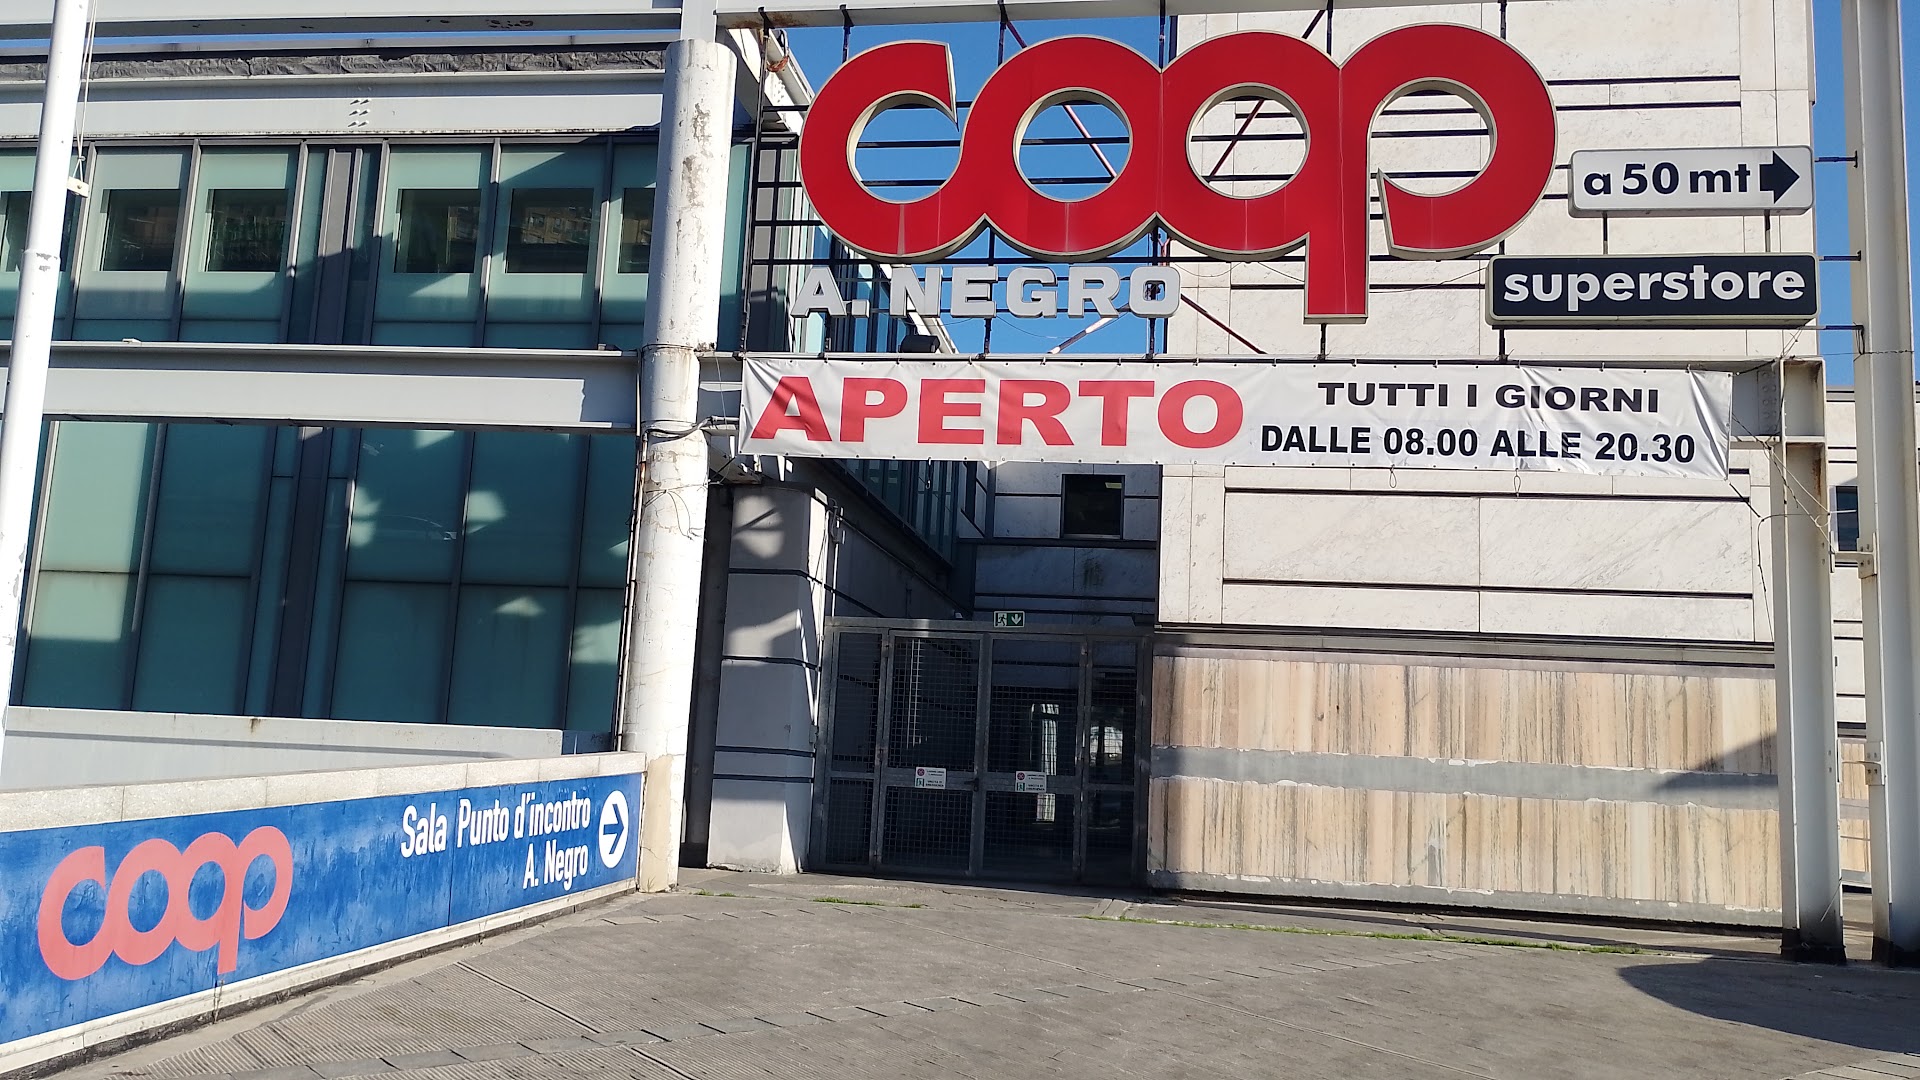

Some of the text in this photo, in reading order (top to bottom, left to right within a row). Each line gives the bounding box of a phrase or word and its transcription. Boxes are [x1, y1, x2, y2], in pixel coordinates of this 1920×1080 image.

[800, 21, 1557, 322] coop
[1584, 162, 1751, 195] a 50 mt
[790, 265, 1181, 318] A. NEGRO
[1503, 264, 1806, 312] superstore
[750, 376, 1244, 449] APERTO
[1317, 382, 1660, 413] TUTTI I GIORNI
[1260, 425, 1696, 464] DALLE 08.00 ALLE 20.30
[400, 790, 592, 858] Sala Punto d'incontro
[522, 838, 589, 892] A. Negro
[37, 825, 294, 982] coop
